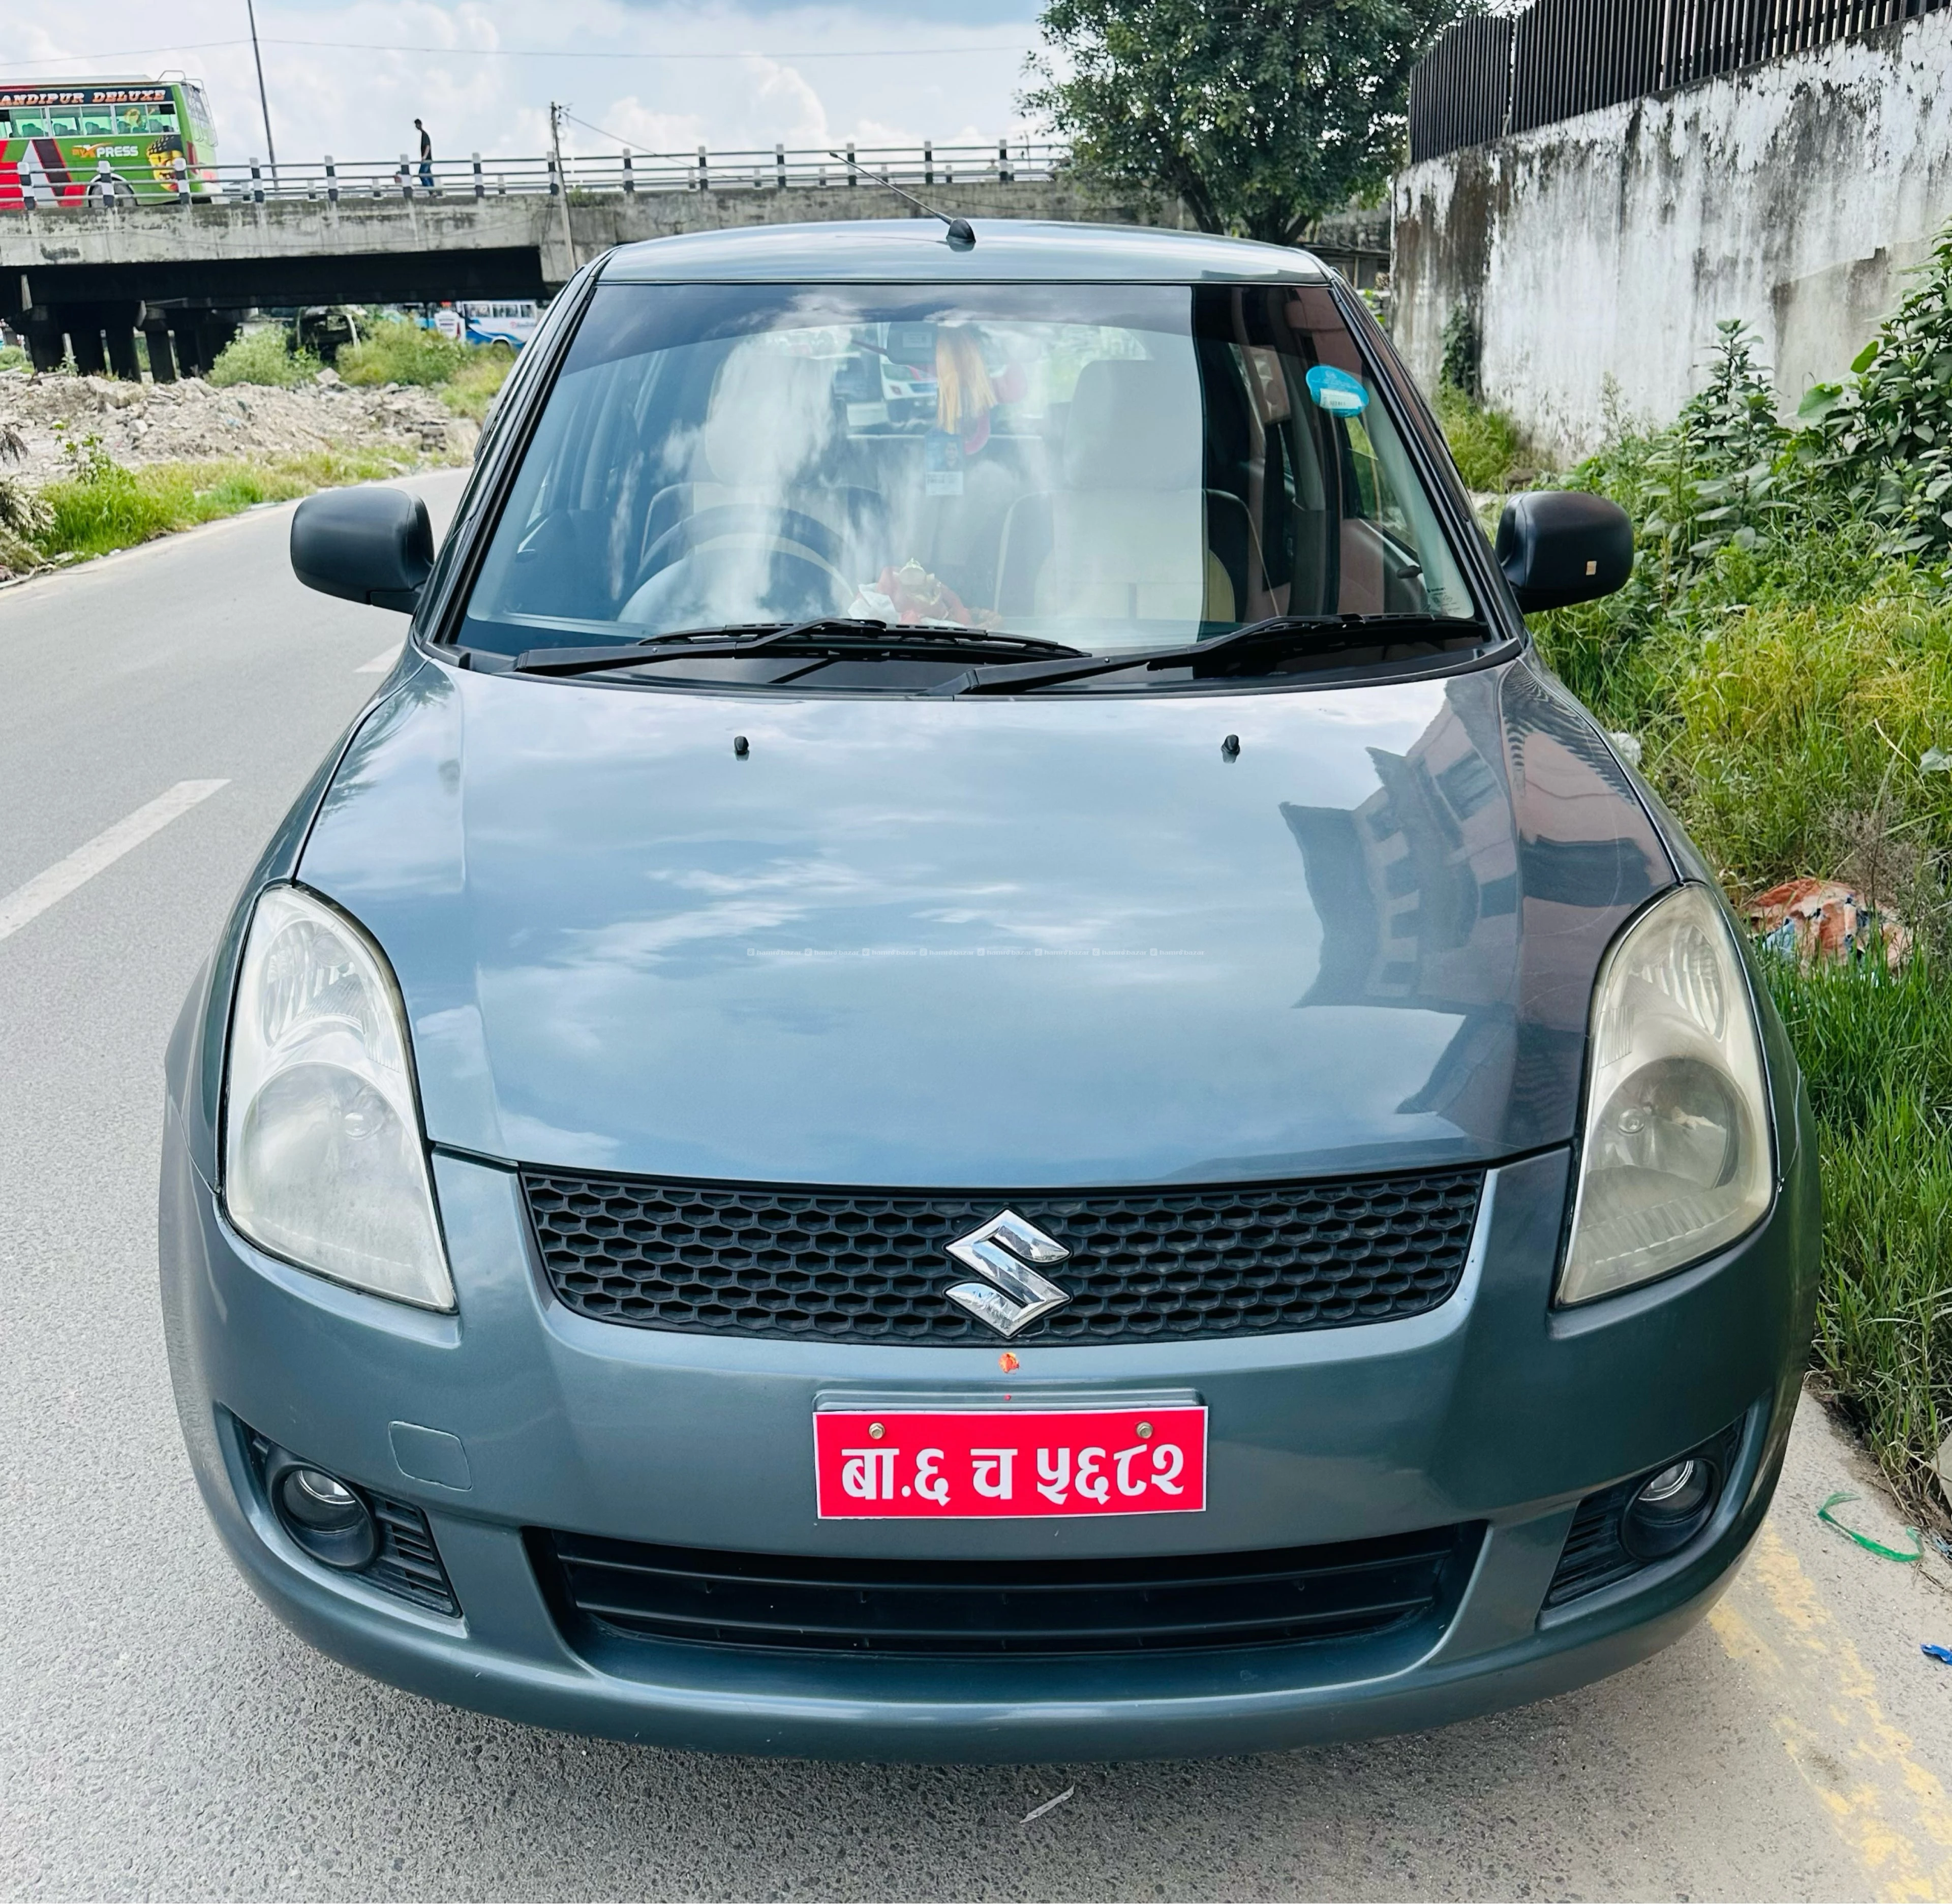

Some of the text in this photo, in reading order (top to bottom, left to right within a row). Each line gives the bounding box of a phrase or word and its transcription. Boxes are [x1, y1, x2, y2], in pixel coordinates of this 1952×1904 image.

[92, 89, 166, 103] DELUXE
[970, 1448, 1018, 1499] च
[1036, 1443, 1184, 1505] ५६८२
